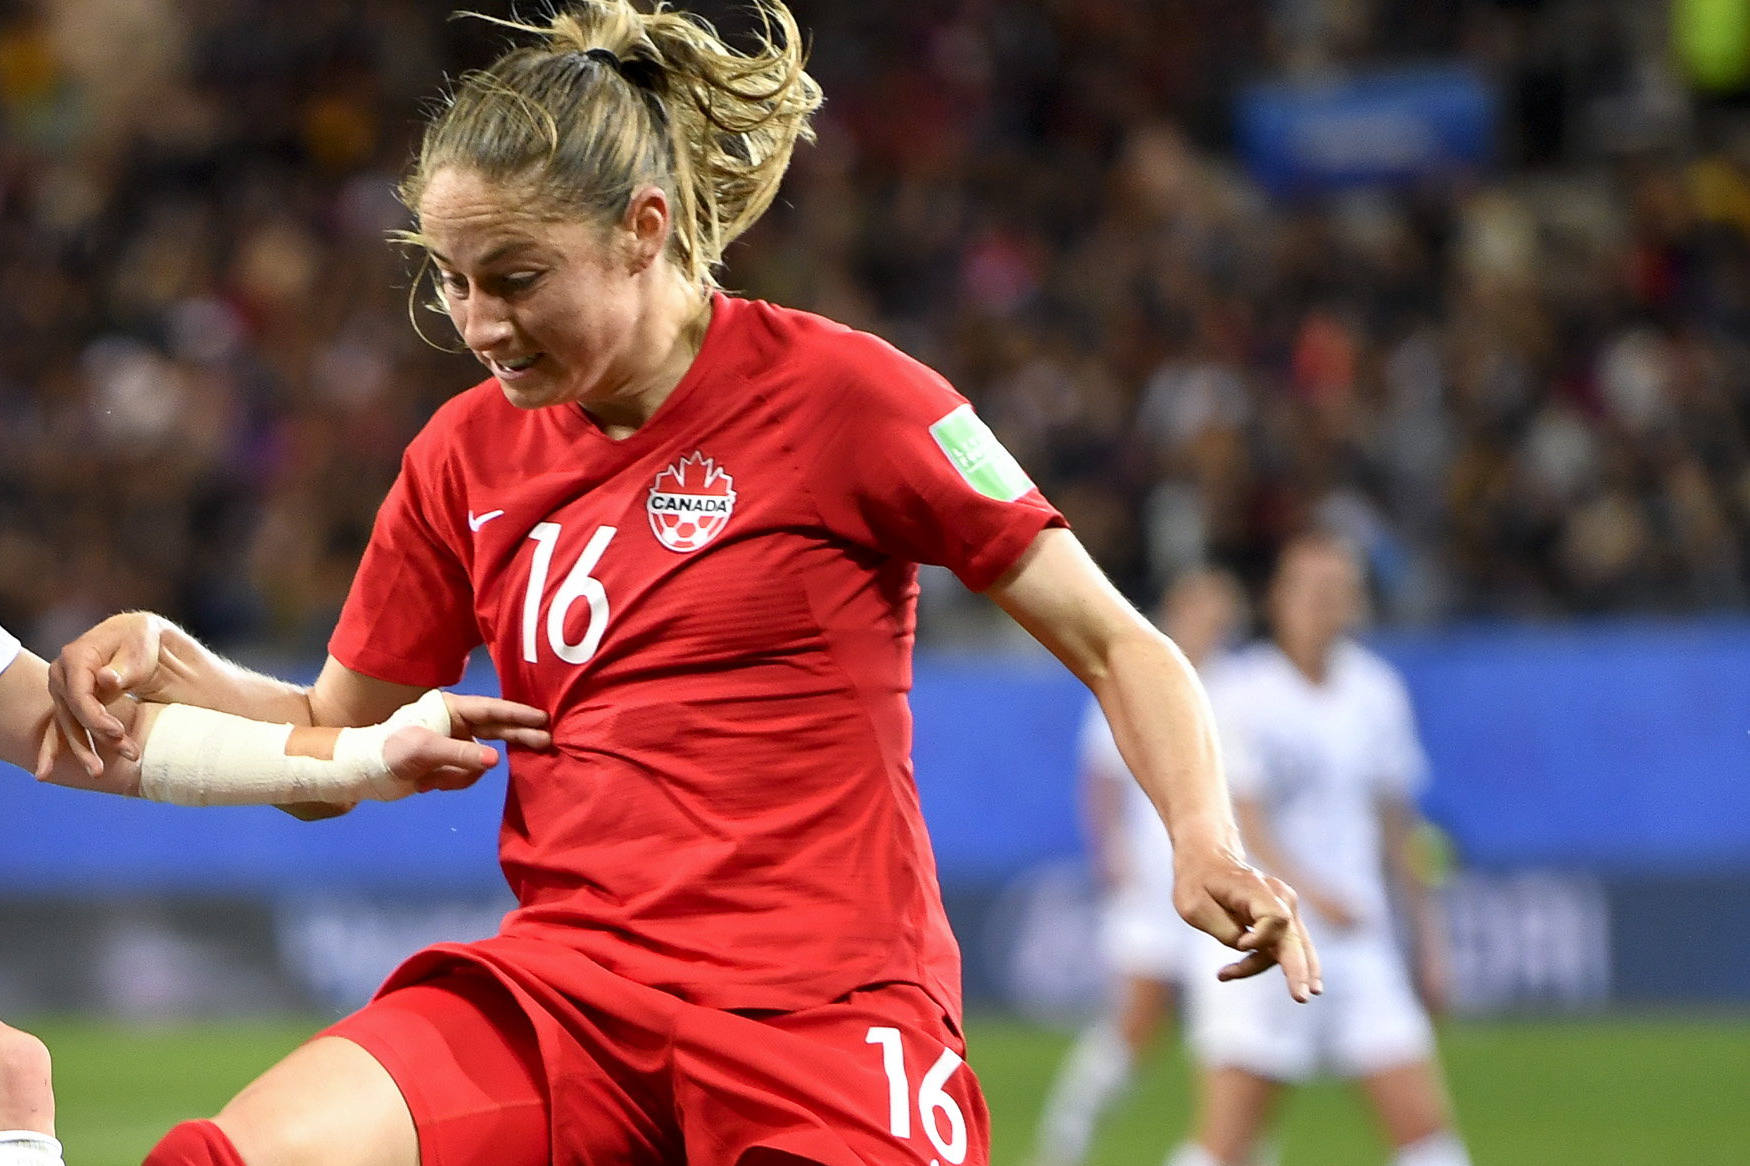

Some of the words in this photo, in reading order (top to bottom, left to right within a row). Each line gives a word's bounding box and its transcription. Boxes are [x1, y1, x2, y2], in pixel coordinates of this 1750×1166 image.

[651, 496, 727, 512] CANADA
[522, 522, 618, 665] 16
[865, 1026, 968, 1165] 16
